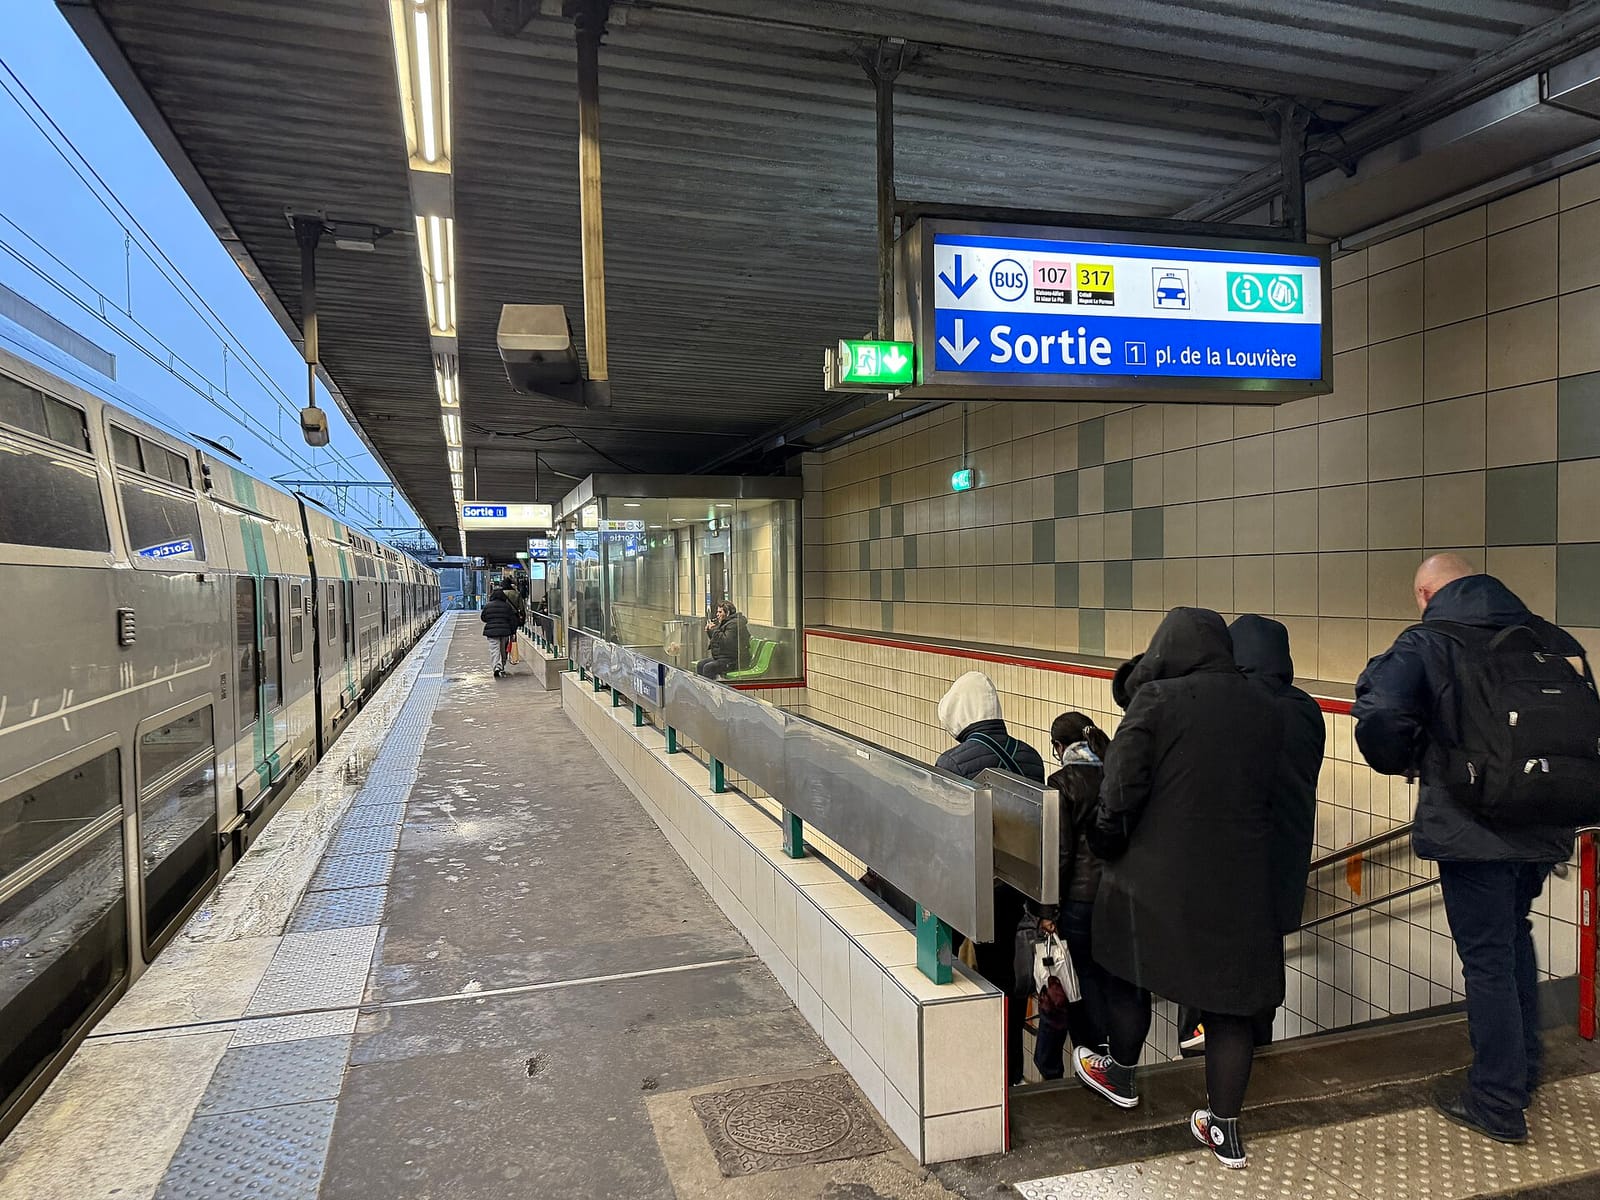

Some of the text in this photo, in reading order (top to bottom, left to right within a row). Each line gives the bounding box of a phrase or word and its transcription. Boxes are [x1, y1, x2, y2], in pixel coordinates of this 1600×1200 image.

[995, 271, 1024, 288] BUS
[1038, 267, 1067, 284] 107
[1081, 269, 1110, 286] 317
[990, 325, 1112, 366] Sortie
[1156, 345, 1176, 367] pl.
[1180, 346, 1201, 364] de
[1207, 347, 1221, 365] la
[1226, 348, 1297, 367] Louvière
[464, 507, 494, 516] Sortie
